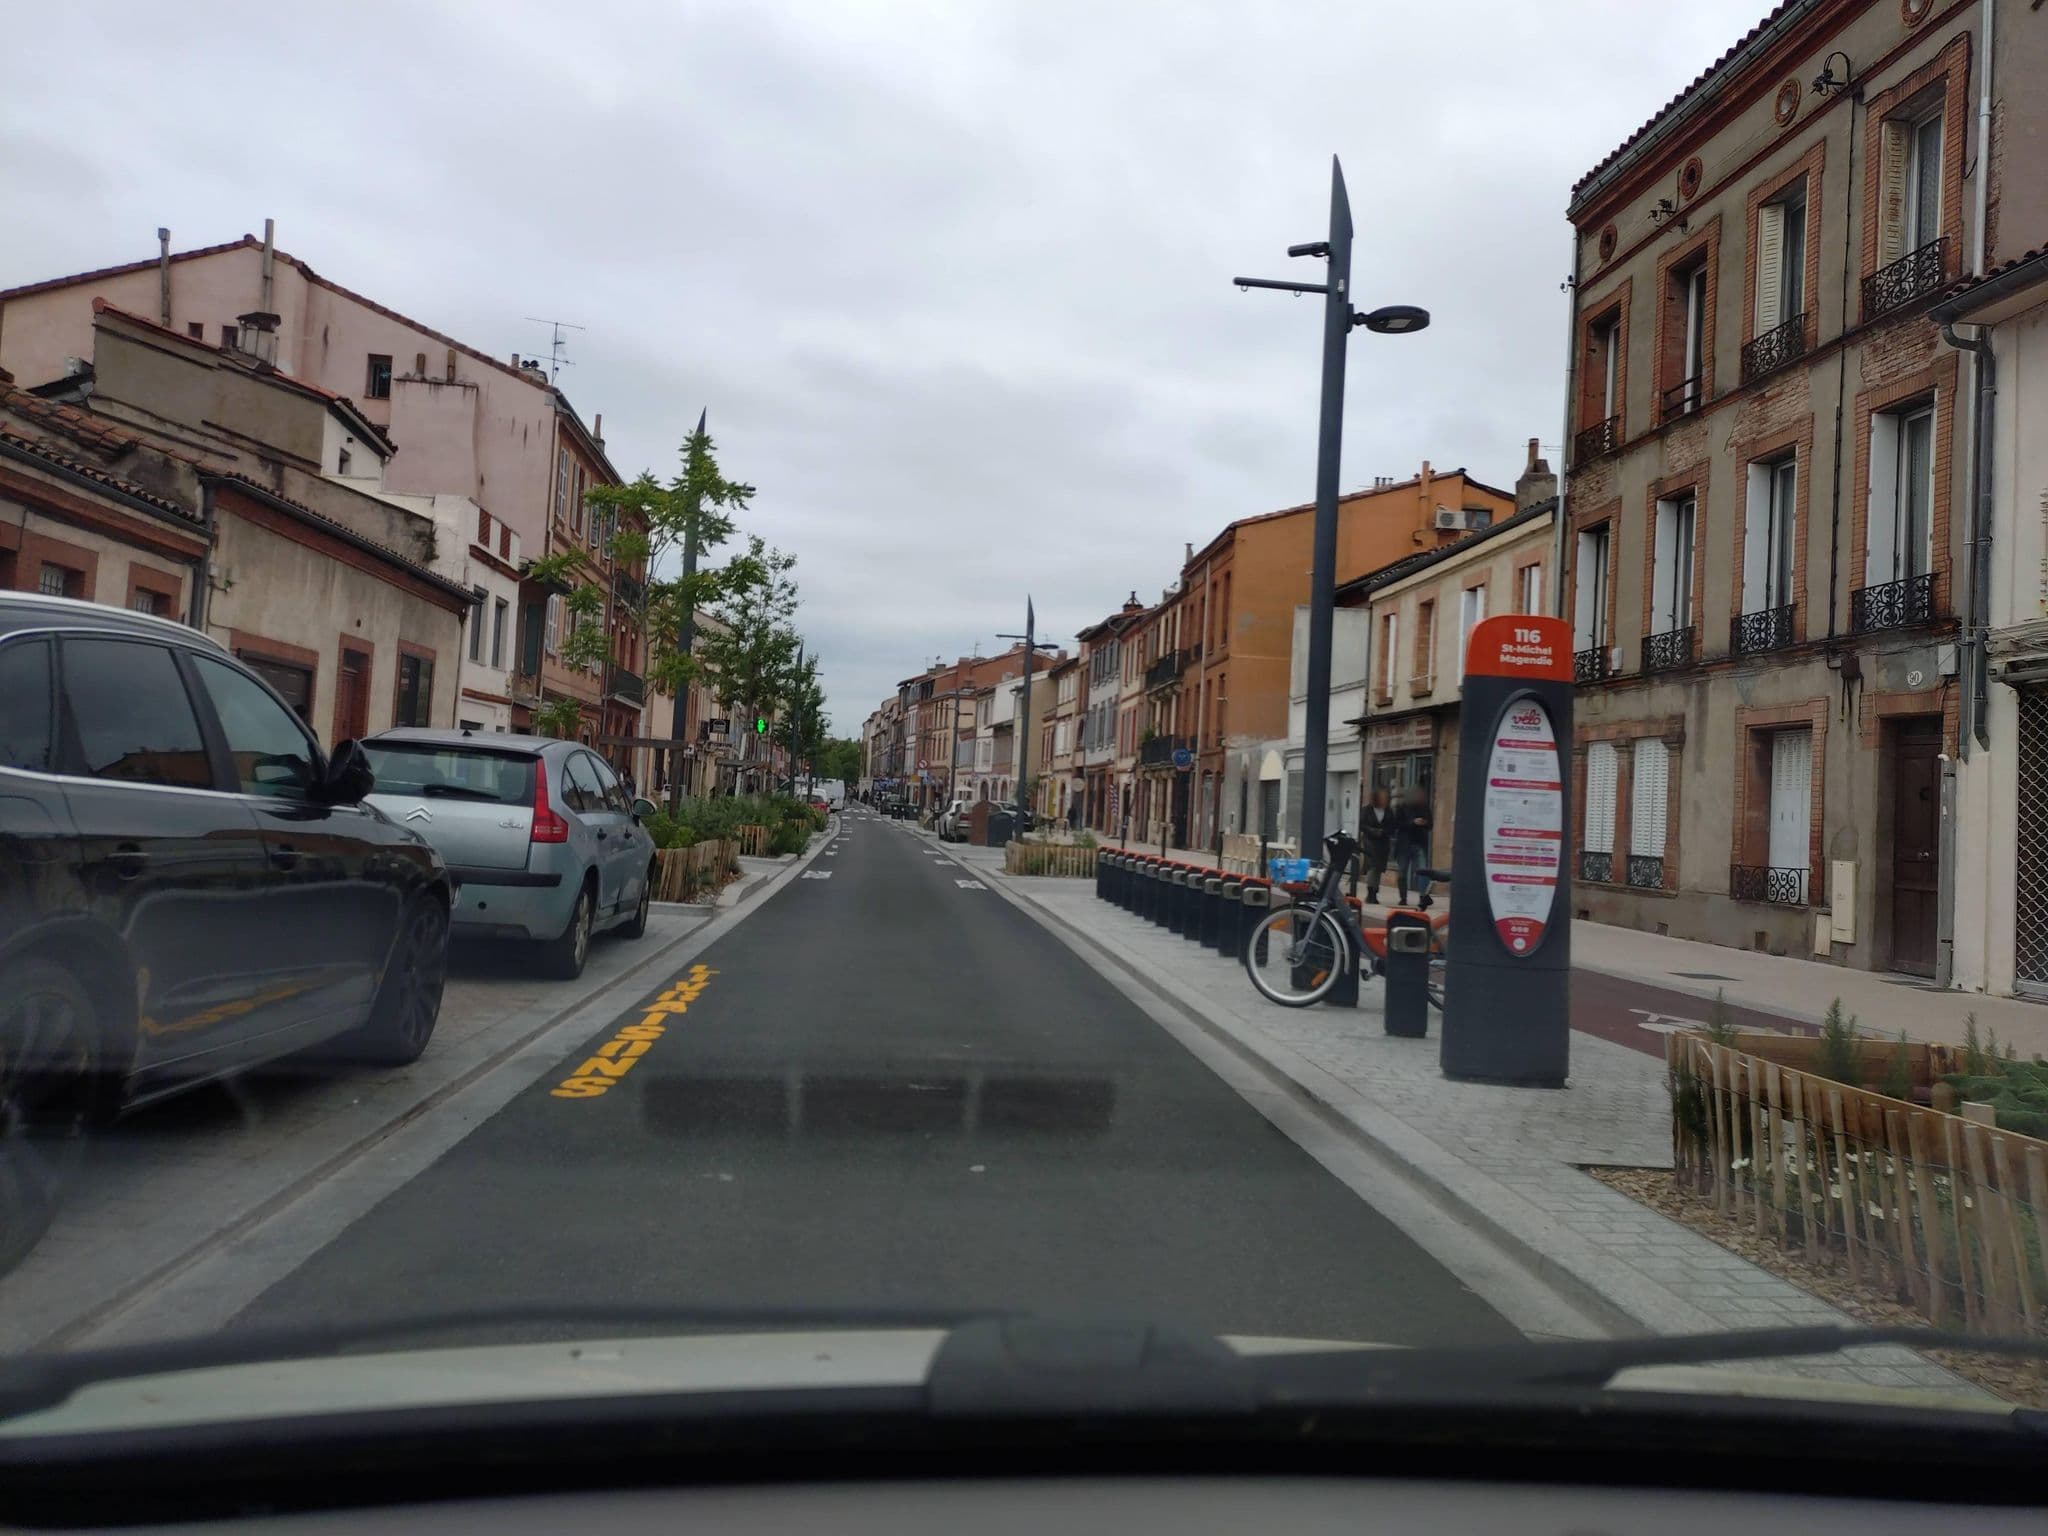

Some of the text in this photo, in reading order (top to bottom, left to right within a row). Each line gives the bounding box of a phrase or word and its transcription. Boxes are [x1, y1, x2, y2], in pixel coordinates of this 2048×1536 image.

[1514, 628, 1541, 643] 116
[1501, 644, 1552, 655] St-Michel
[1499, 653, 1553, 666] Magendie
[1909, 672, 1920, 683] 90
[549, 964, 721, 1098] LIVRAISONS
